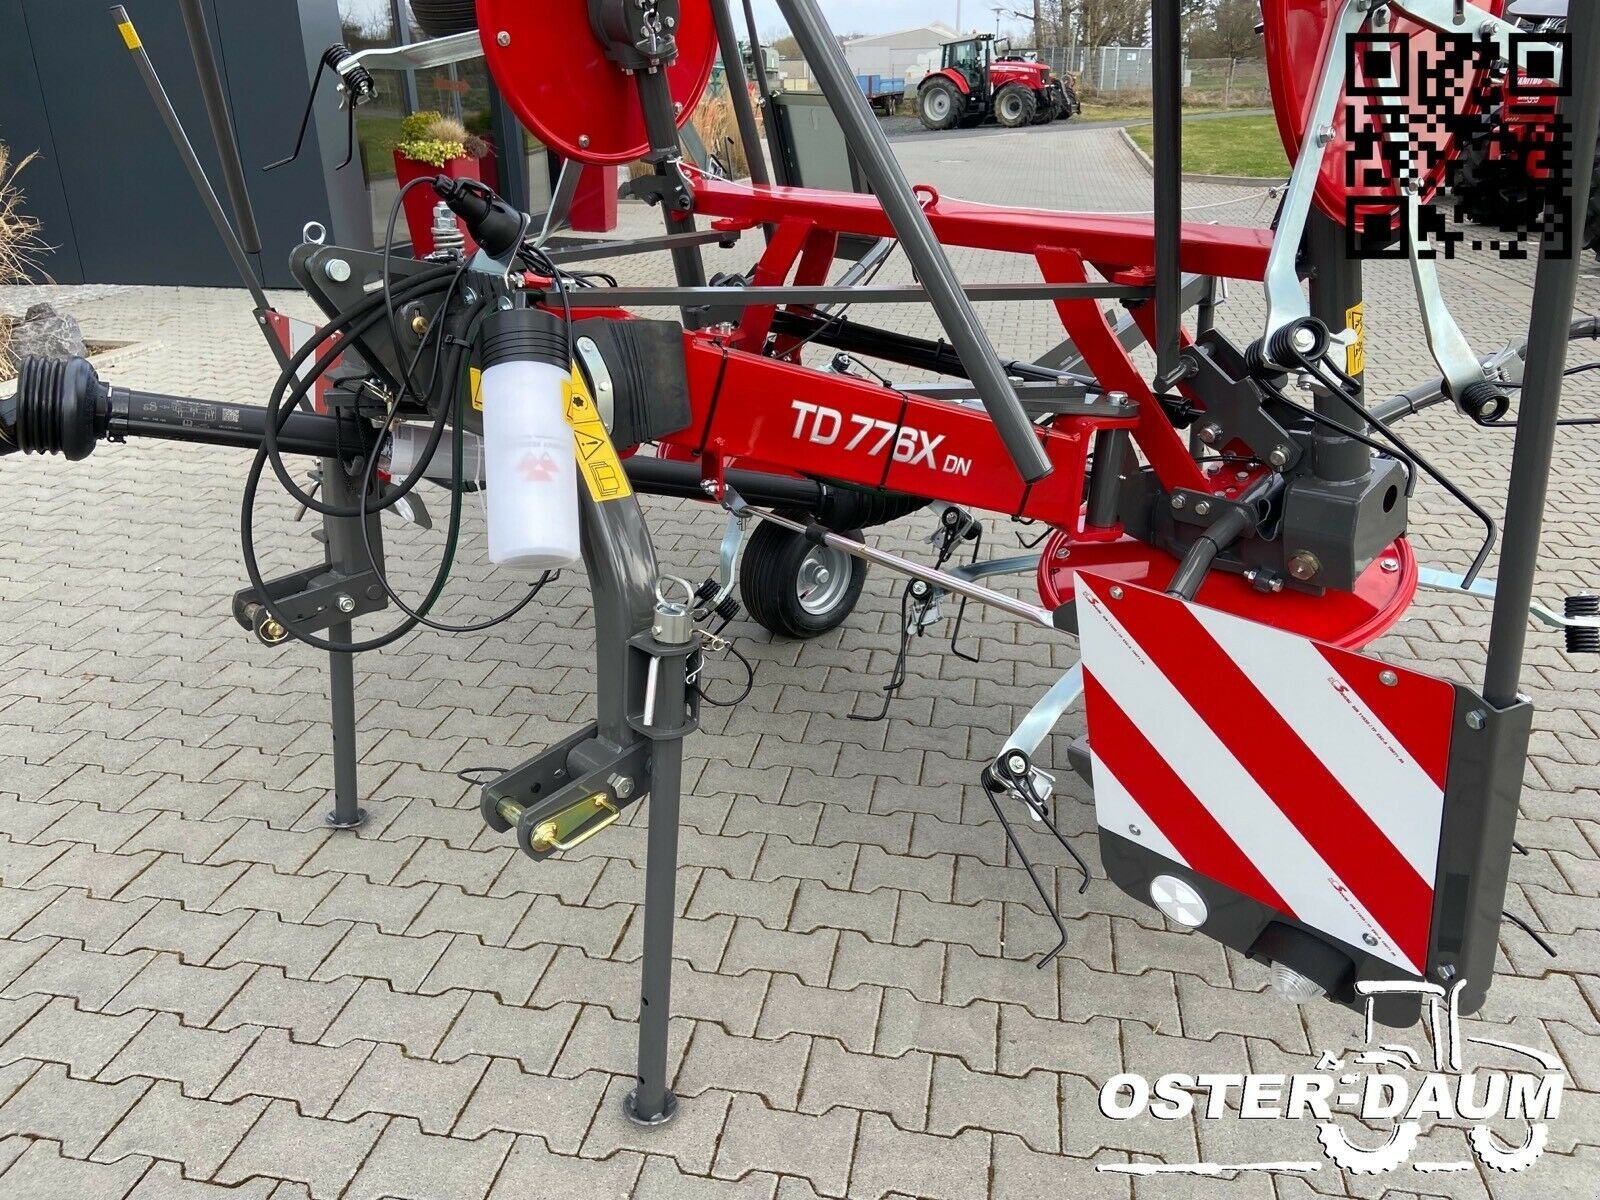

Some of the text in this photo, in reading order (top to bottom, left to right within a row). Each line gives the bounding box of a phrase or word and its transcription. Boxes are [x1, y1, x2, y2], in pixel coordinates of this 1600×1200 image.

[1516, 76, 1543, 85] ANITOU
[791, 399, 972, 476] TD 776X DN
